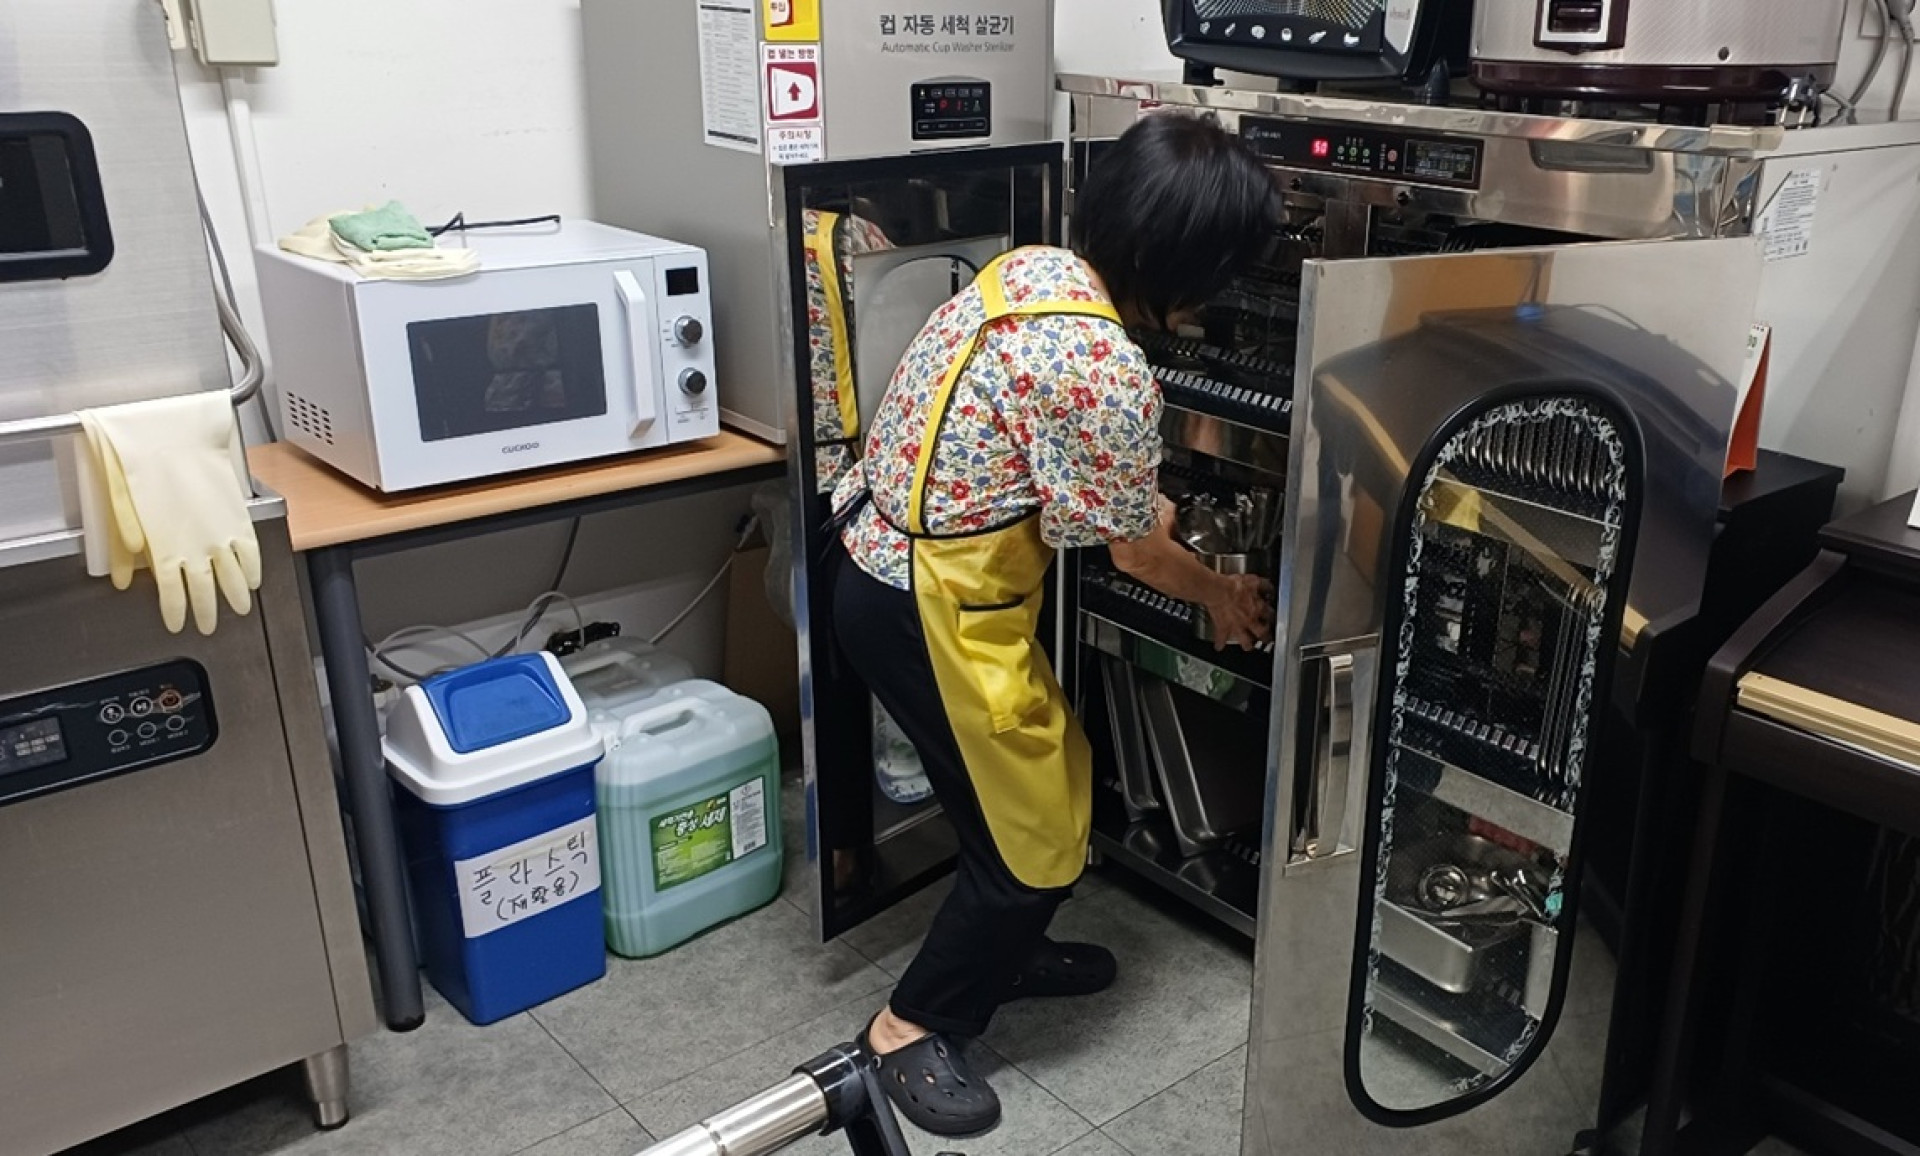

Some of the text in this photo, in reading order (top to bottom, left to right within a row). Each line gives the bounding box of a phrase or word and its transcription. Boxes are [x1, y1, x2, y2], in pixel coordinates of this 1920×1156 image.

[880, 14, 1014, 35] 컵 자동 세척 살균기
[767, 48, 776, 59] 컵
[881, 41, 930, 53] Automatic
[932, 42, 951, 54] Cup
[952, 42, 982, 52] Washer
[501, 442, 539, 454] CUCKOO
[496, 870, 579, 921] (재활용)
